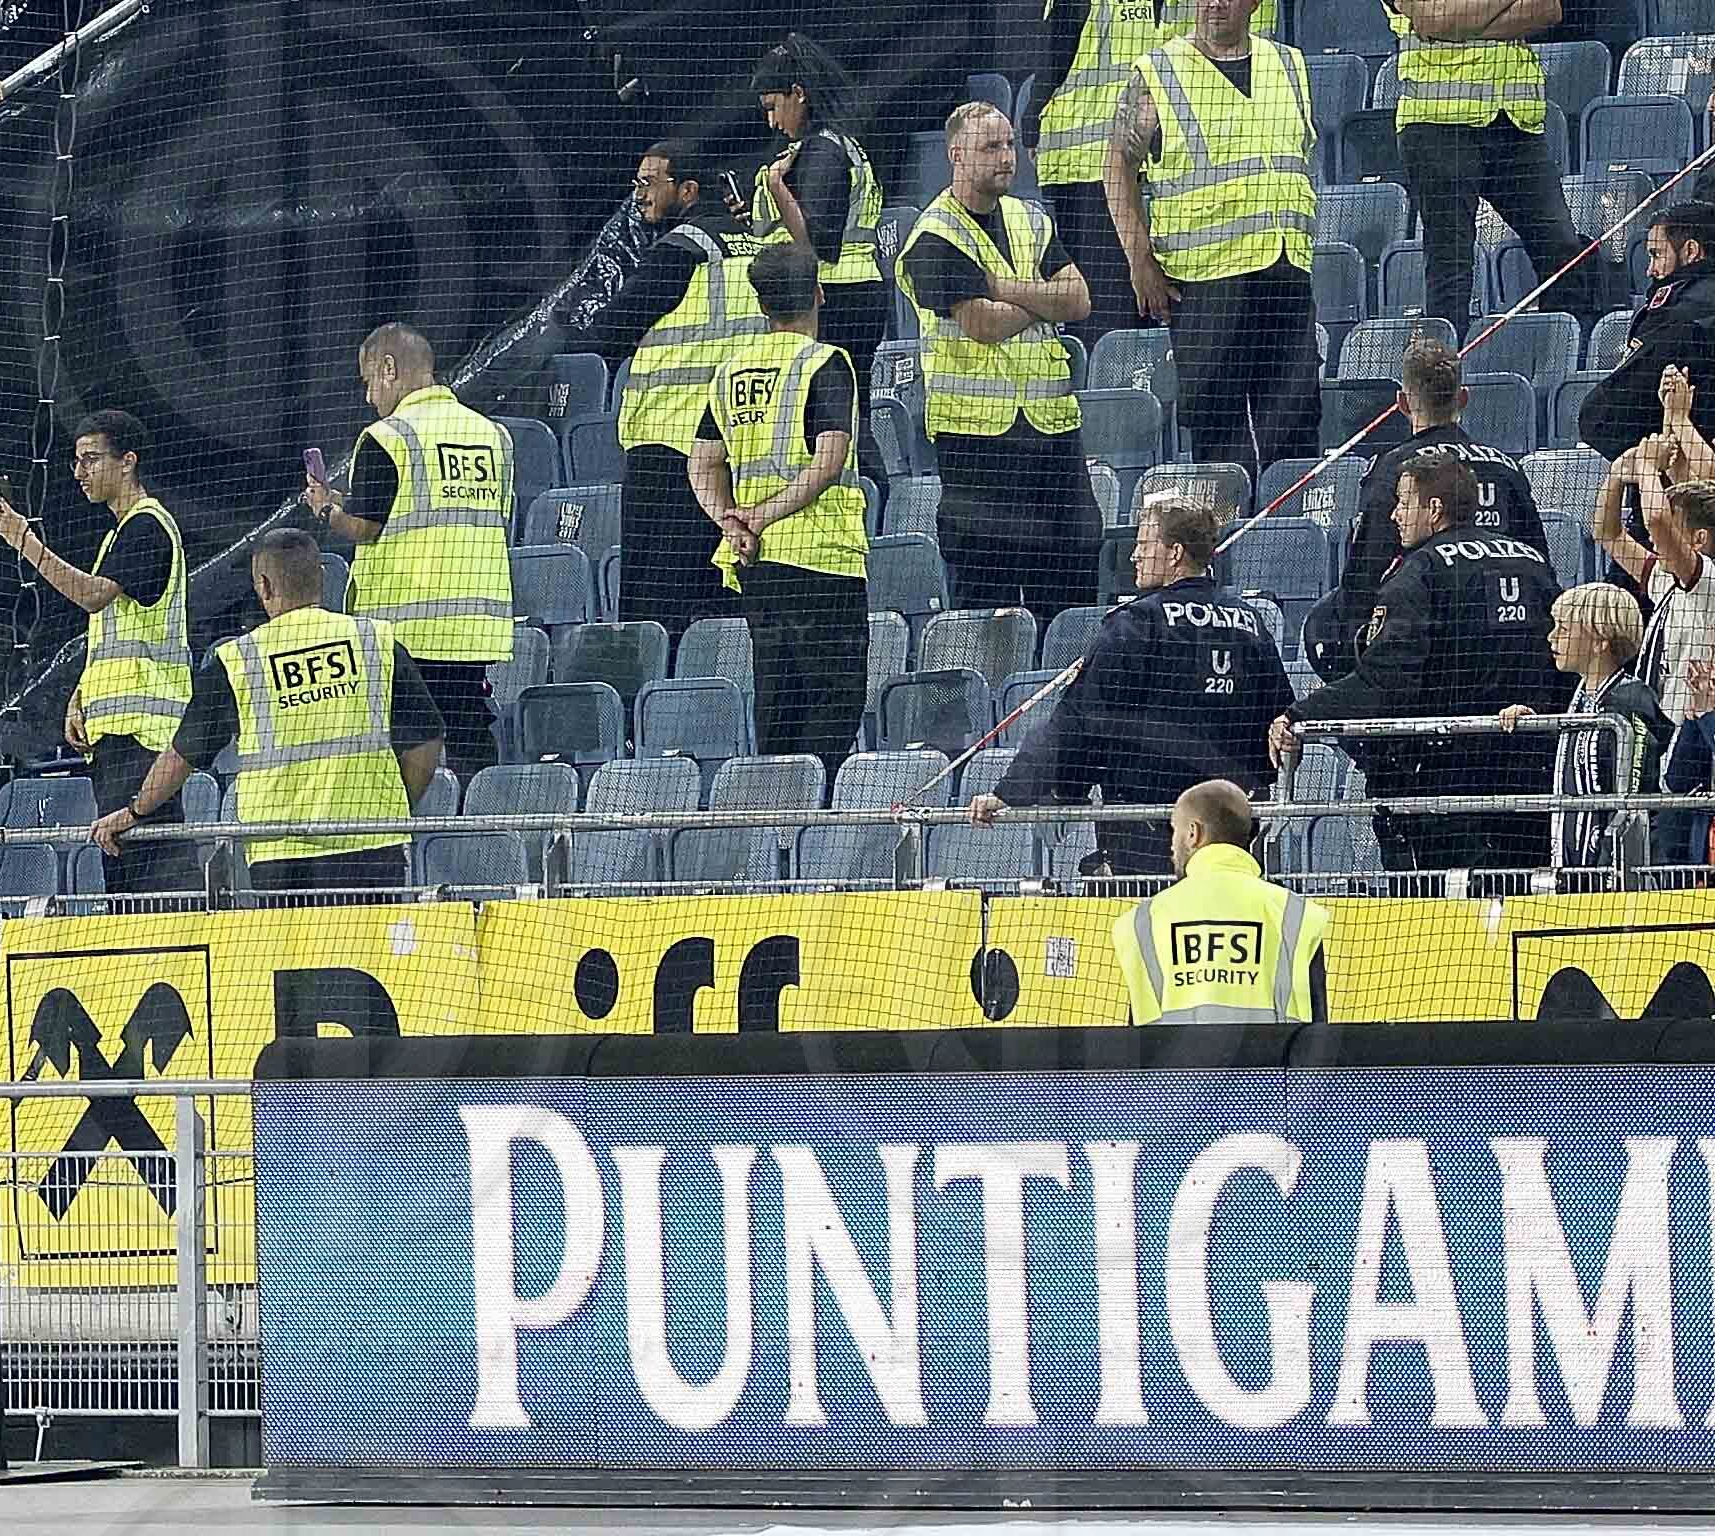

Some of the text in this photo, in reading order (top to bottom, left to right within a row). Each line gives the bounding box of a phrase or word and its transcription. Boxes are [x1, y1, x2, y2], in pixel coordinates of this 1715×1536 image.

[448, 453, 489, 482] BFS
[442, 485, 498, 501] SECURITY
[1476, 483, 1496, 507] U
[1474, 509, 1501, 527] 220
[1499, 577, 1520, 602] U
[1496, 605, 1527, 623] 220
[282, 651, 346, 689] BFS
[1211, 649, 1232, 675] U
[278, 681, 359, 711] SECURITY
[1204, 678, 1234, 695] 220
[1184, 933, 1249, 965] BFS
[1173, 969, 1260, 987] SECURITY
[459, 1104, 1715, 1432] PUNTIGAM
